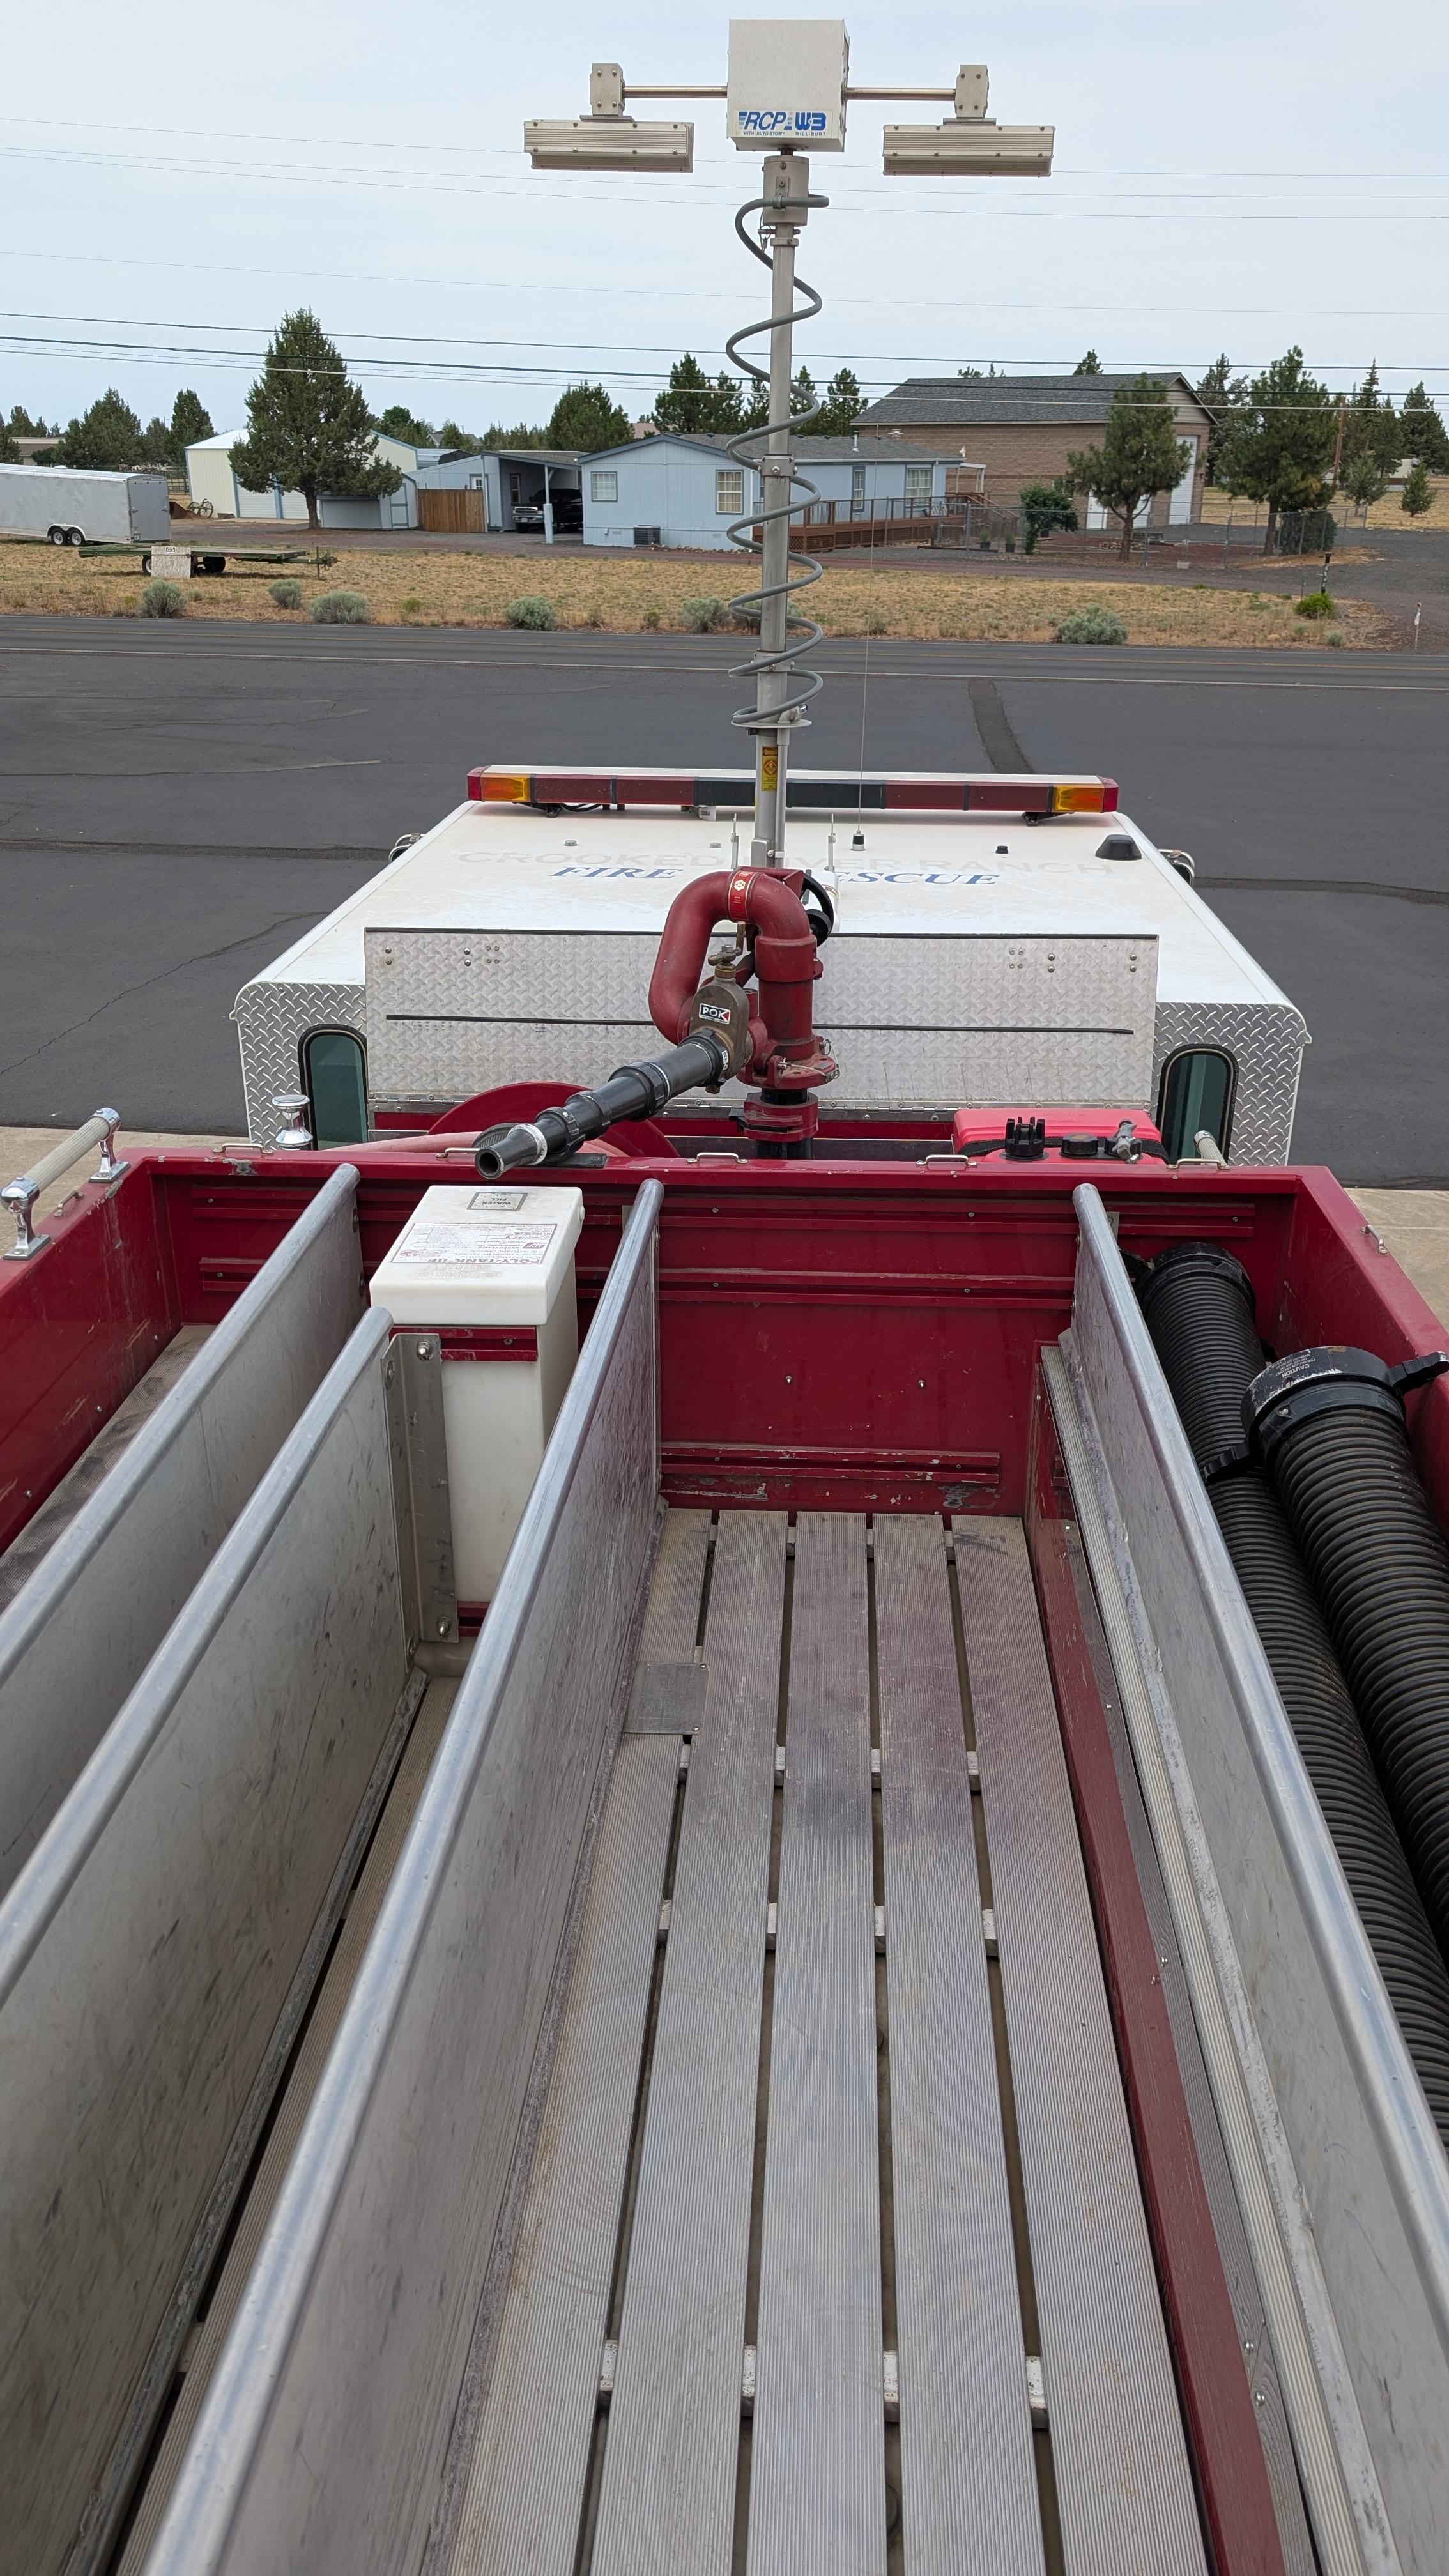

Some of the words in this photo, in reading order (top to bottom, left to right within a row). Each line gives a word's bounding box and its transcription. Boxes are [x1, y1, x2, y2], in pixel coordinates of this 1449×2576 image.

[744, 112, 787, 130] RCP
[458, 852, 723, 866] CROOKED
[919, 858, 1115, 875] RANCH
[549, 866, 684, 878] FIRE
[703, 1006, 729, 1022] POK
[1282, 1363, 1310, 1378] CAUTION
